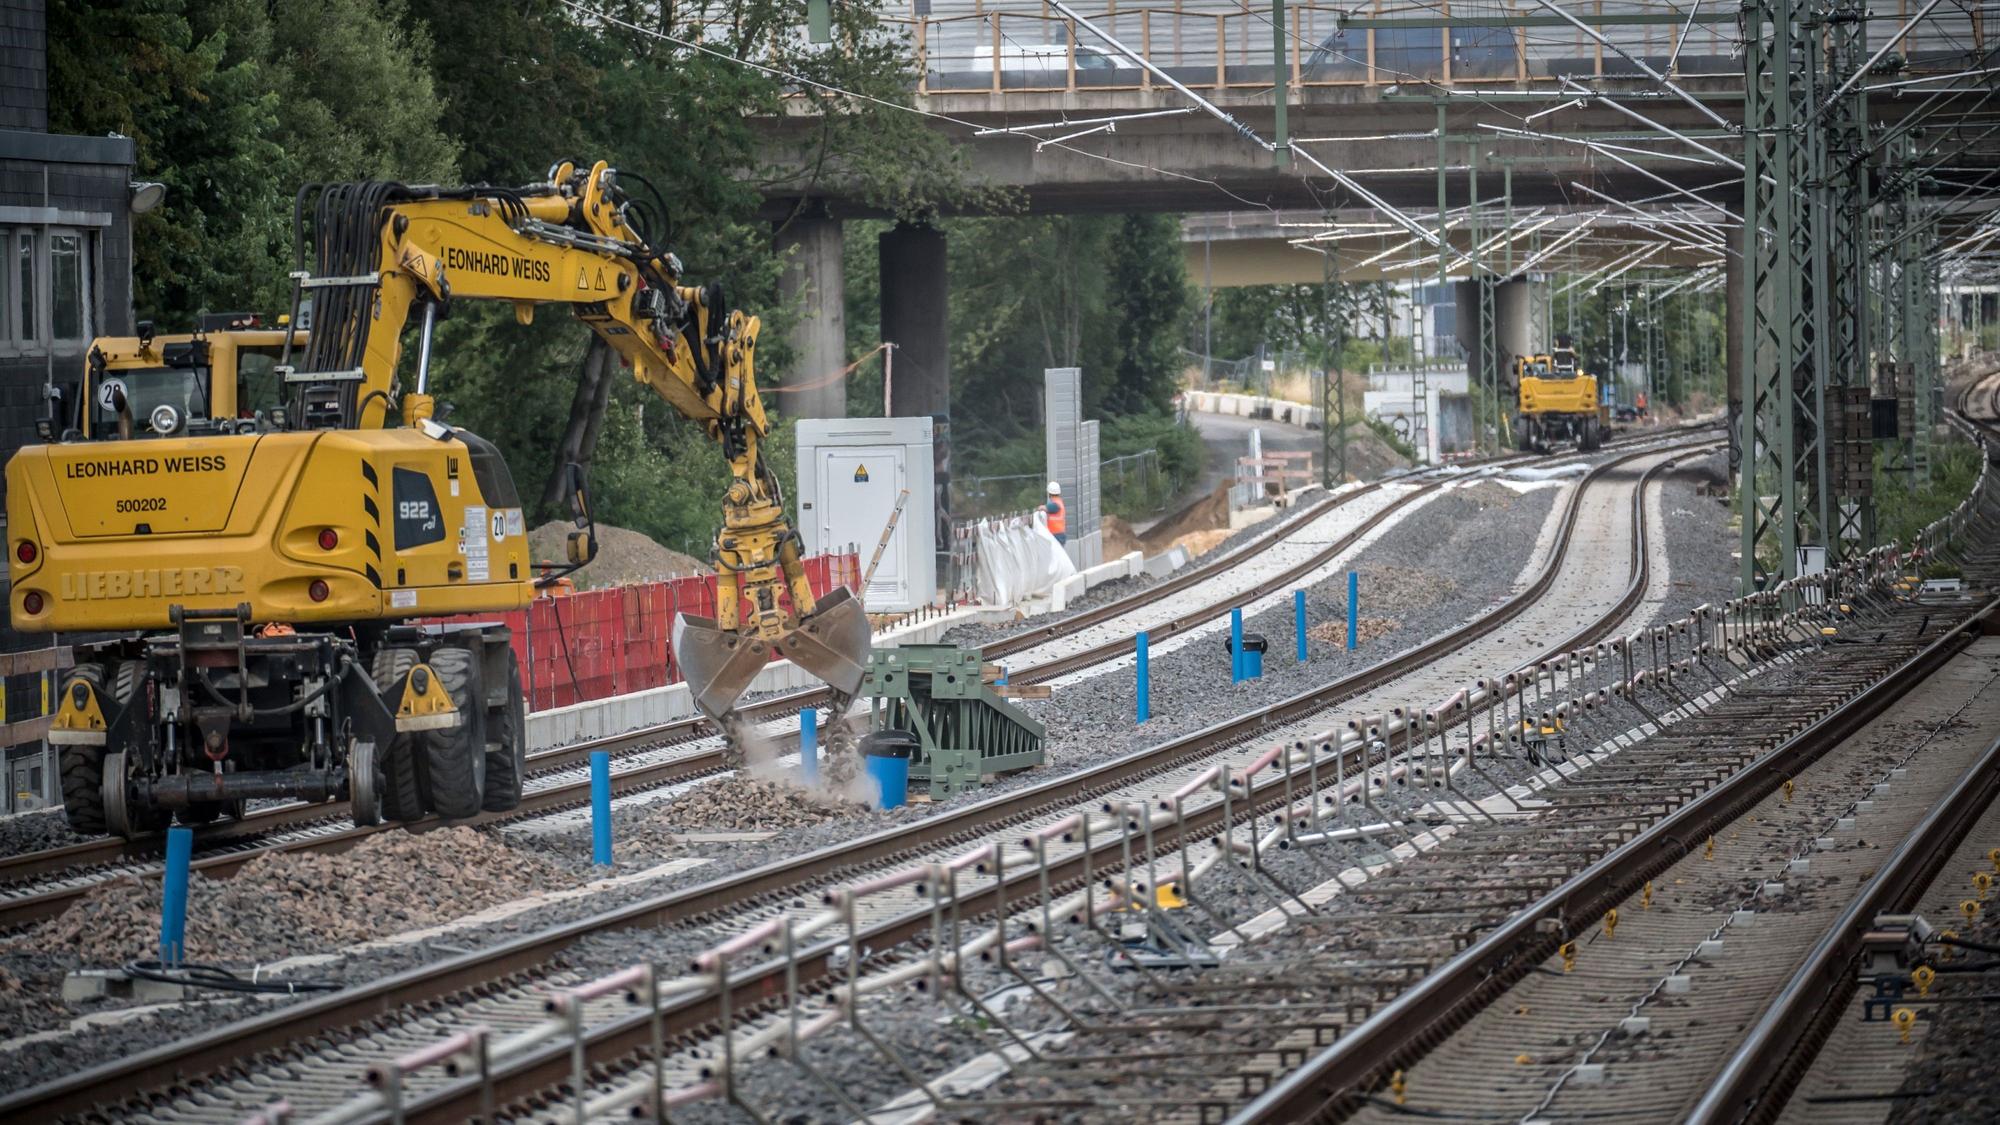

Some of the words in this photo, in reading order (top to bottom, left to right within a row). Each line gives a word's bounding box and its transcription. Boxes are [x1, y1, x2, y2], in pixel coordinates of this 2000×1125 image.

[511, 256, 550, 283] WEISS
[67, 459, 159, 479] LEONHARD
[164, 455, 227, 473] WEISS
[116, 498, 167, 513] 500202
[399, 501, 429, 519] 922
[494, 516, 504, 536] 20
[61, 565, 246, 601] LIEBHERR
